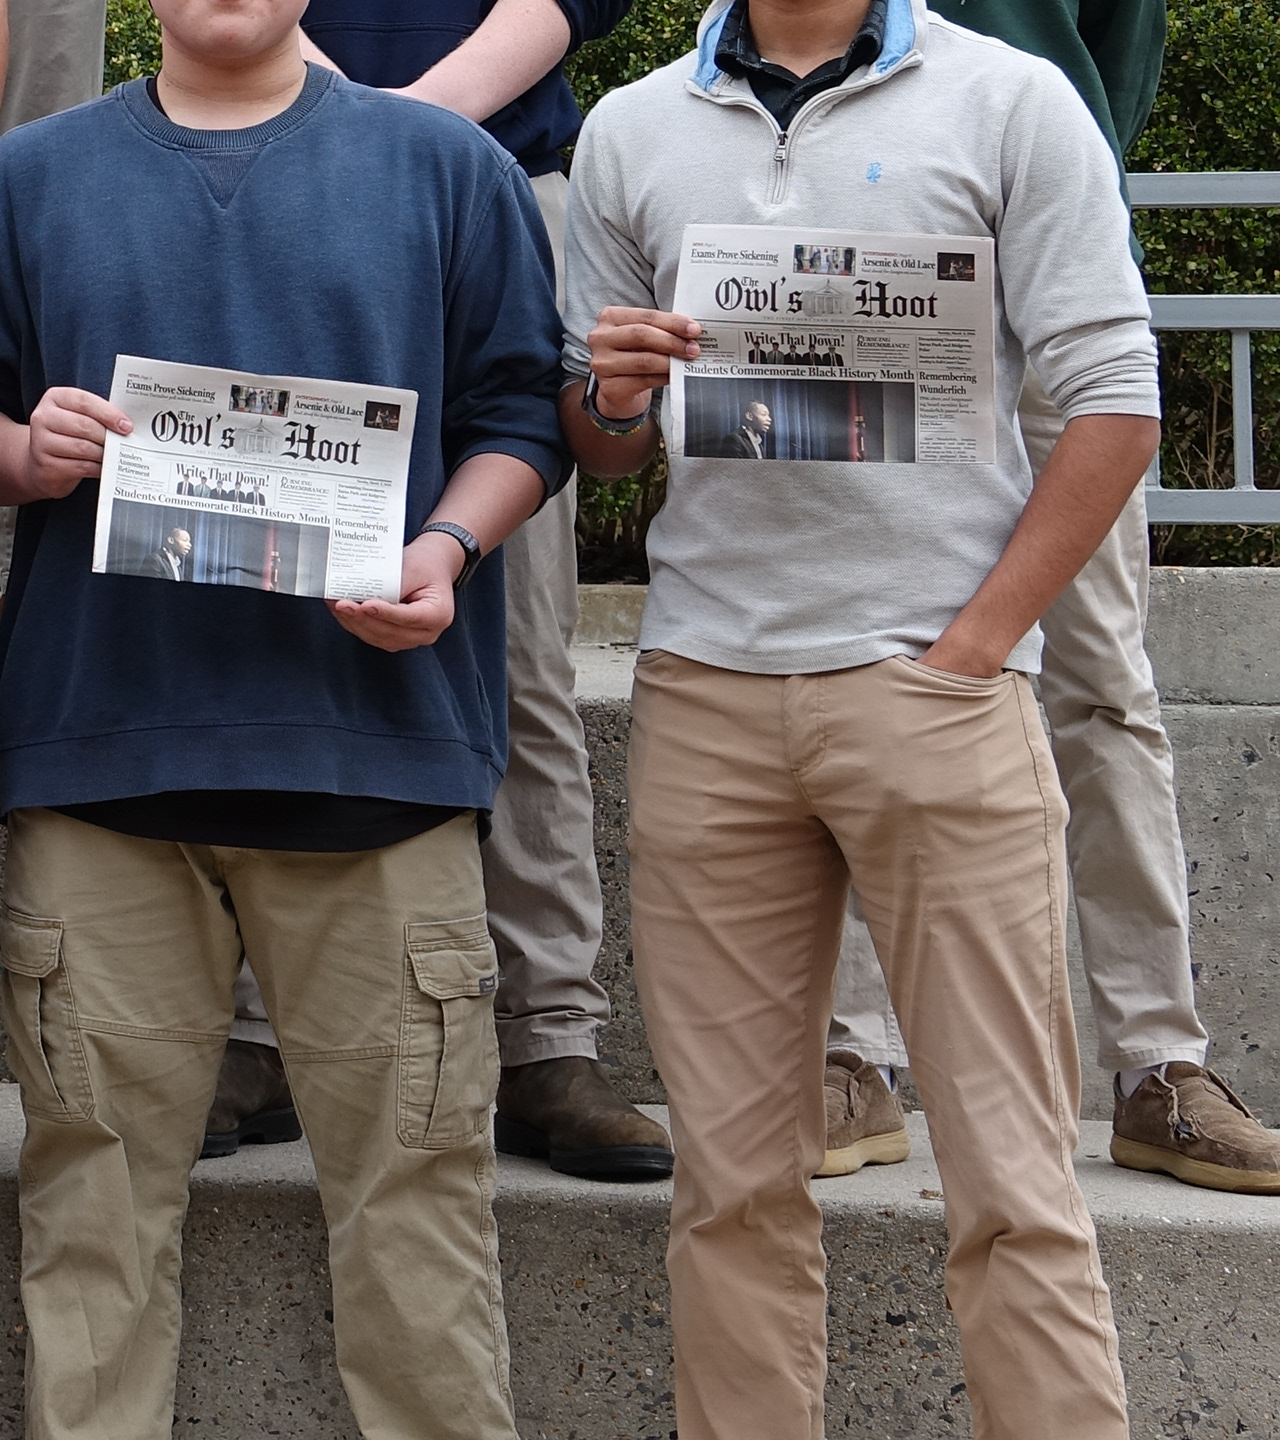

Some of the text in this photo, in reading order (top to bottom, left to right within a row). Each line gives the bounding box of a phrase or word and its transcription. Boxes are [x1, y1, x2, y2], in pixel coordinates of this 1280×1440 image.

[690, 248, 779, 263] Exams Prove Sickening
[861, 257, 936, 269] Arsenic Old Lace
[714, 276, 938, 319] The Owl's Hoot
[744, 330, 845, 347] Write That Down!
[684, 362, 914, 381] Students Commemorate Black History Month
[919, 371, 977, 384] Remembering
[126, 379, 216, 401] Exams Prove Sickening
[919, 384, 967, 395] Wunderlich
[152, 410, 362, 465] The Owl's Hoot
[175, 462, 270, 487] Write That Down!
[113, 487, 331, 525] Students Commemorate Black History Month
[334, 517, 389, 534] Remembering
[333, 529, 379, 543] Wunderlich
